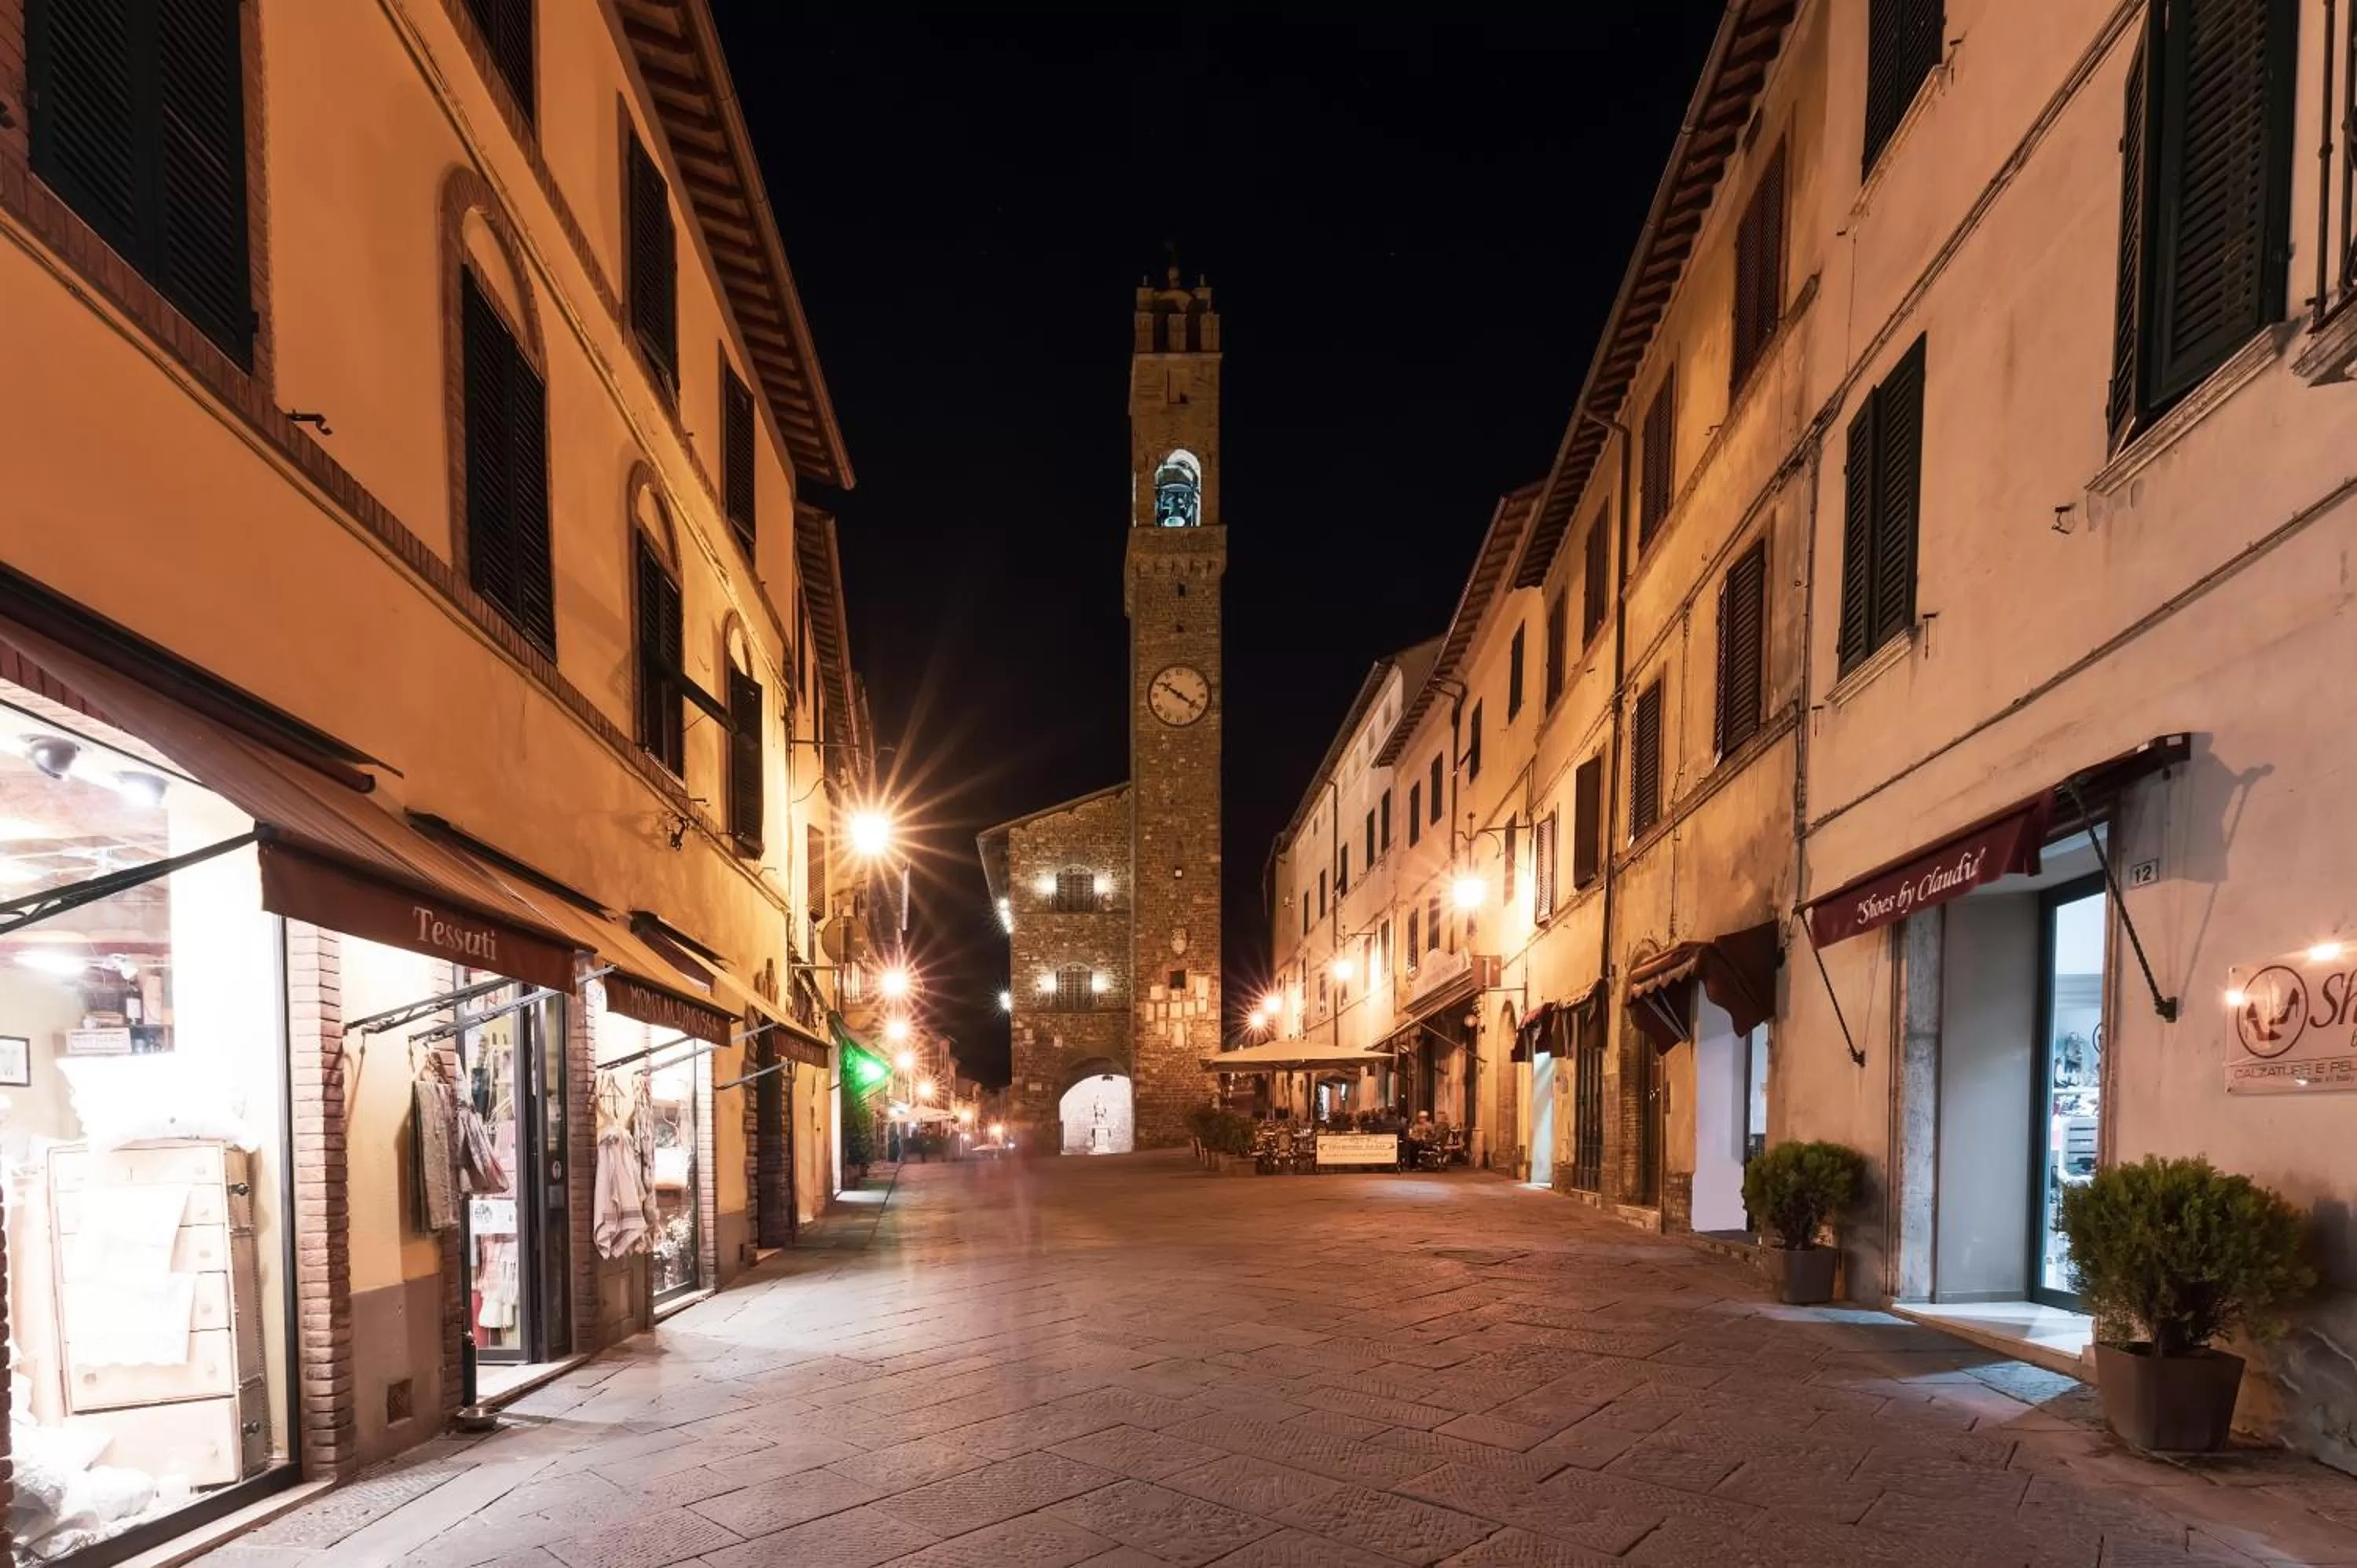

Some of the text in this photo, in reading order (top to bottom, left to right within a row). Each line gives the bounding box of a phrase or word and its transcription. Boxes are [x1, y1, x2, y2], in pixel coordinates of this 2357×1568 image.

[2135, 865, 2152, 884] 12
[1897, 881, 1915, 914] by
[412, 906, 497, 961] Tessuti
